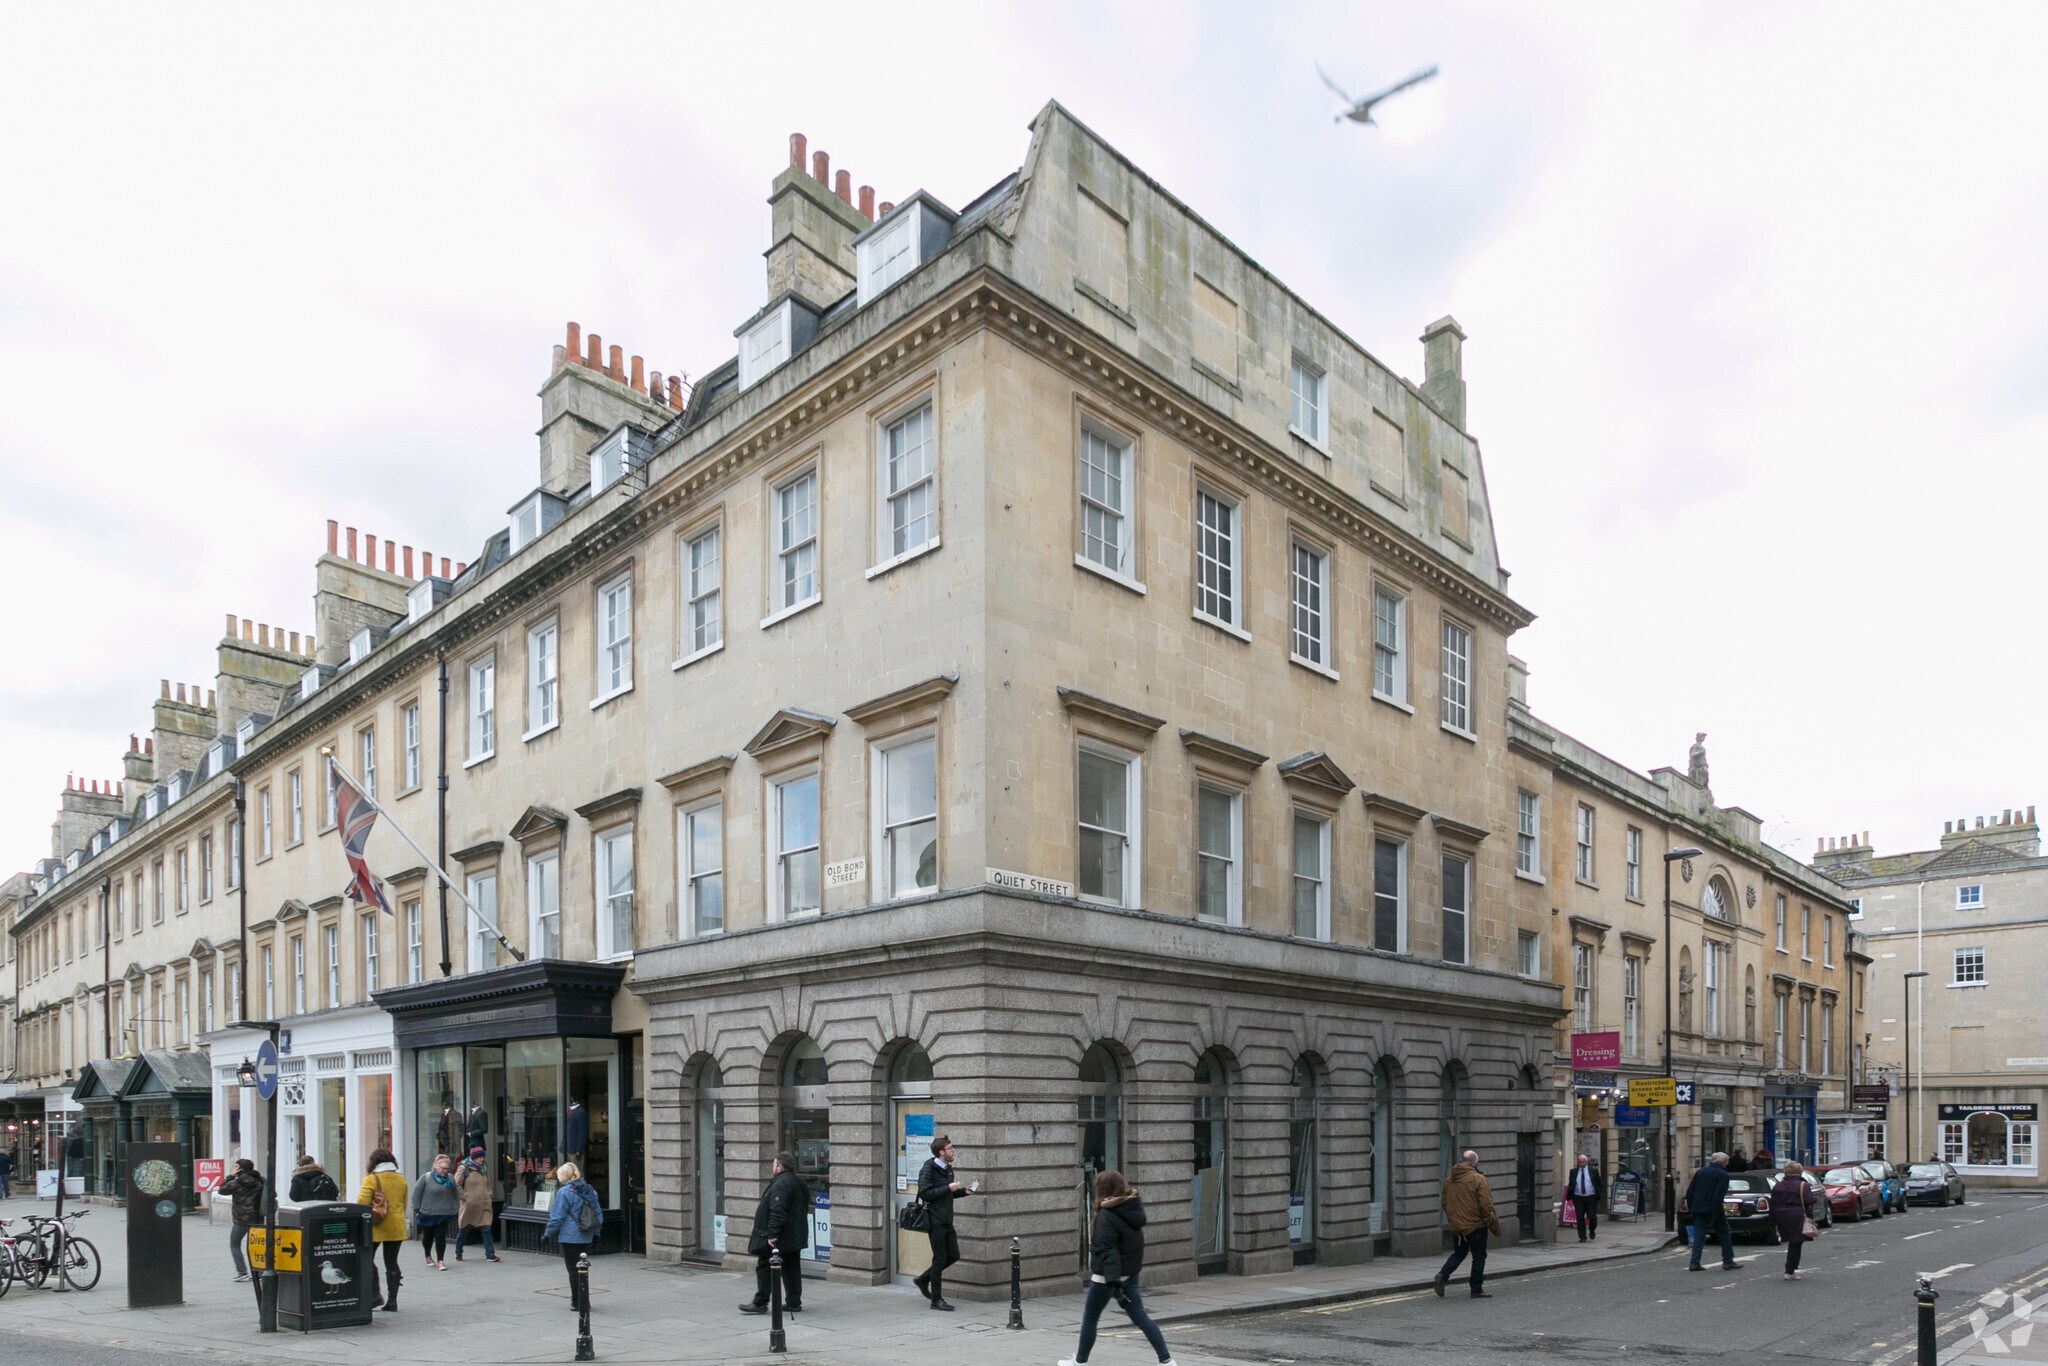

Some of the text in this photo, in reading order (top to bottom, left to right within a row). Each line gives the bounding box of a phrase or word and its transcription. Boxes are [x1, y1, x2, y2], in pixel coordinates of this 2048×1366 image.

[827, 860, 864, 876] OLD BOND
[832, 871, 858, 884] STREET
[994, 872, 1068, 896] QUIET STREET
[1576, 1048, 1615, 1059] Dressing
[1779, 1075, 1807, 1084] TSB
[518, 1157, 551, 1173] SALE
[817, 1222, 828, 1232] TO
[1291, 1218, 1301, 1226] LET
[250, 1233, 281, 1247] Dived
[325, 1248, 356, 1256] MOUETTES
